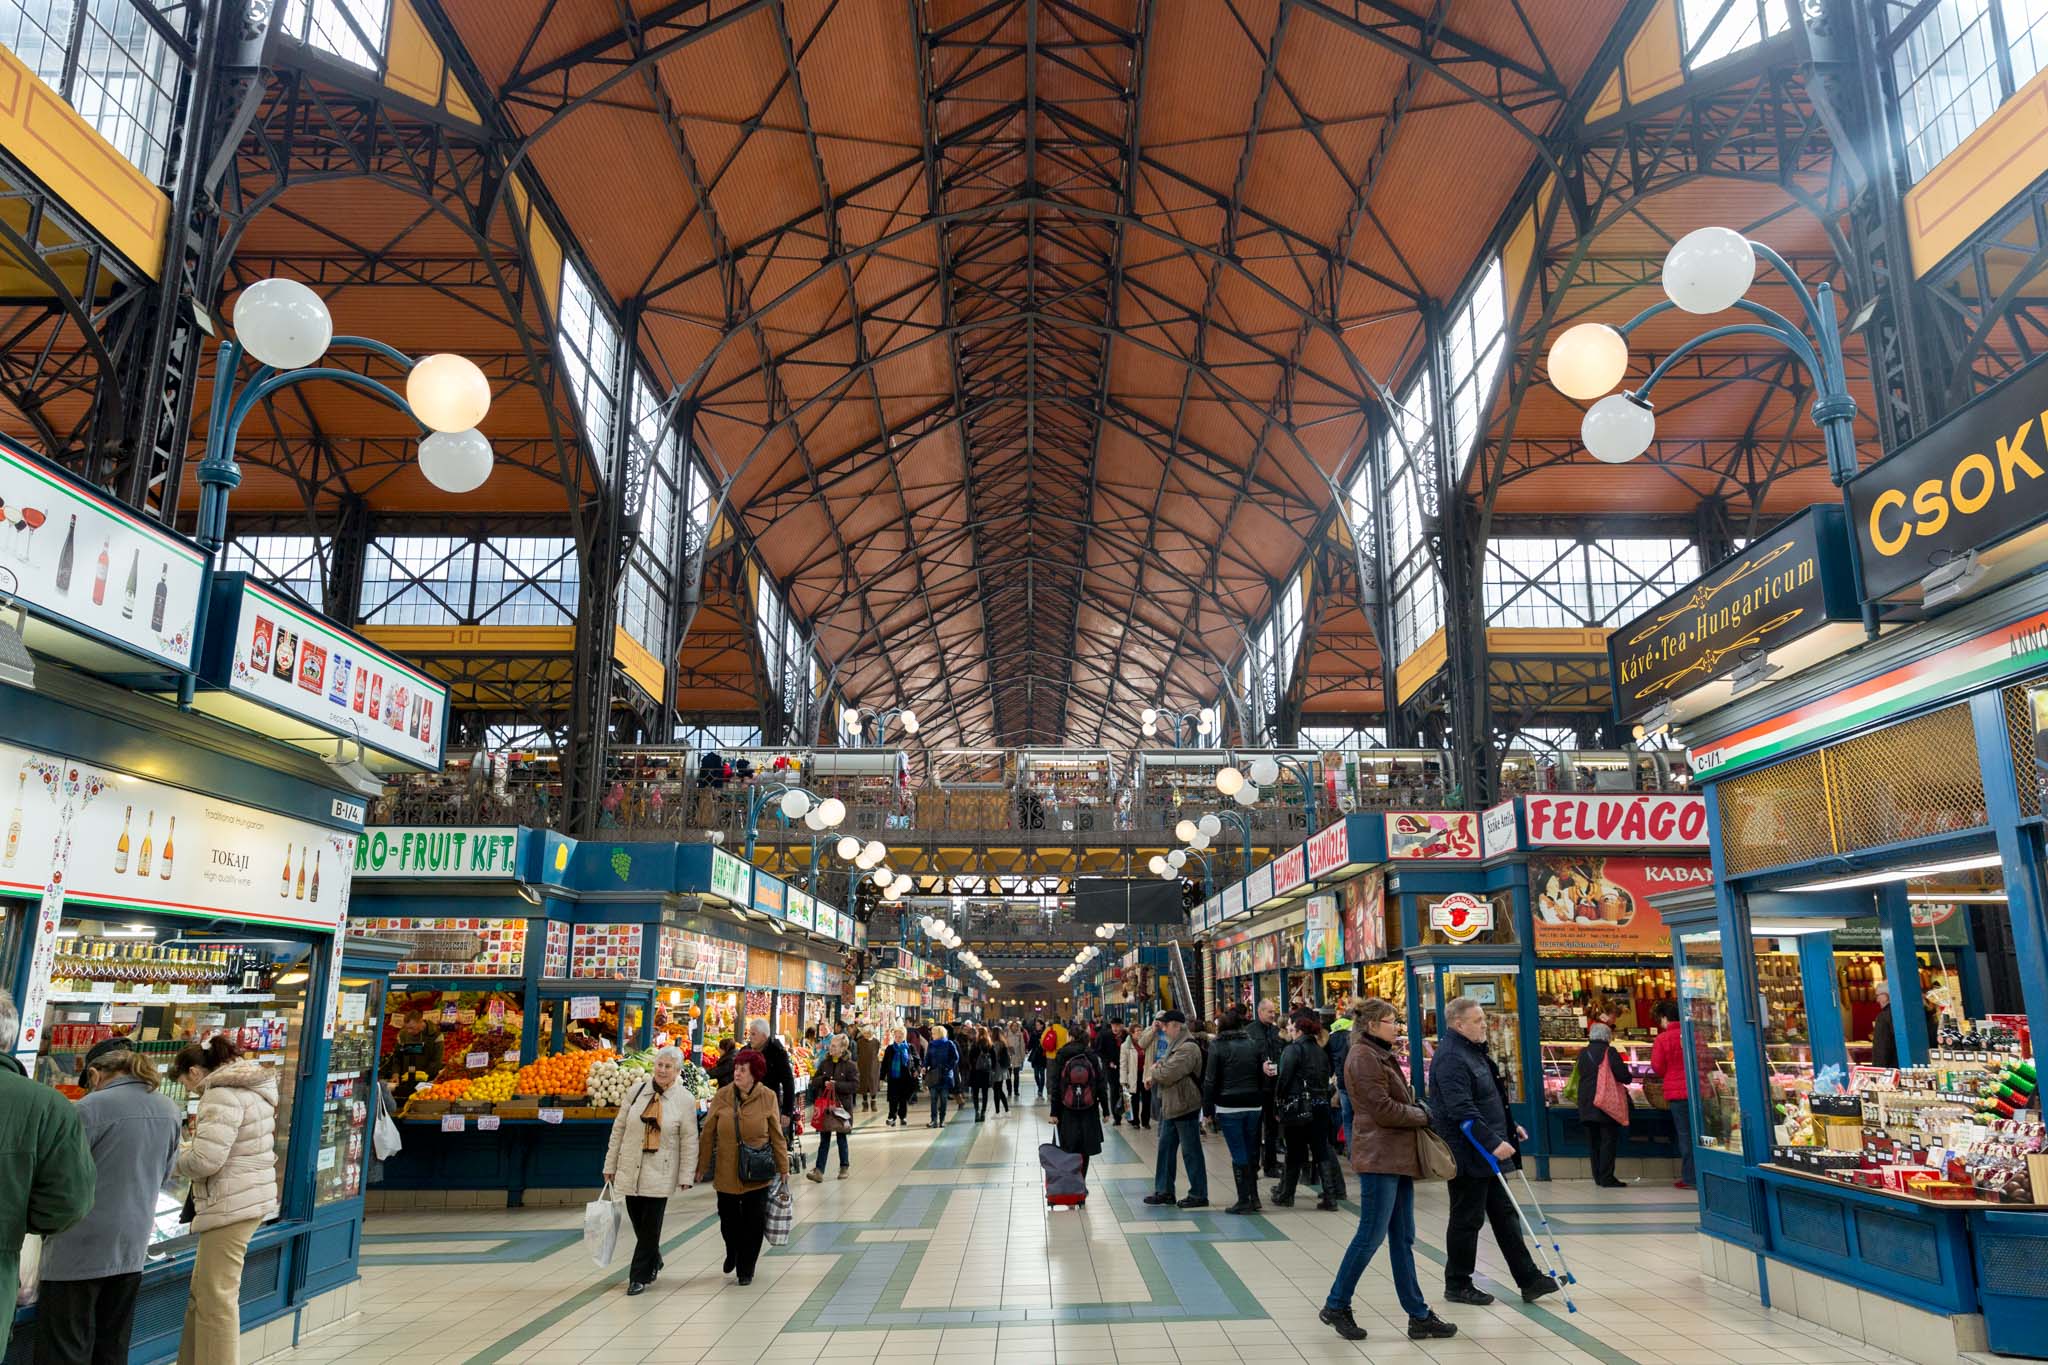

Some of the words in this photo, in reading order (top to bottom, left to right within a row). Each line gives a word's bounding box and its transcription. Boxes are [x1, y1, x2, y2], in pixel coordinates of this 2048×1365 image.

[1620, 643, 1653, 685] Kávé
[1661, 633, 1687, 661] Tea
[1697, 557, 1815, 642] Hungaricum
[1531, 797, 1709, 841] FELVÁGO
[211, 849, 249, 872] TOKAJI
[470, 835, 514, 872] KFT.
